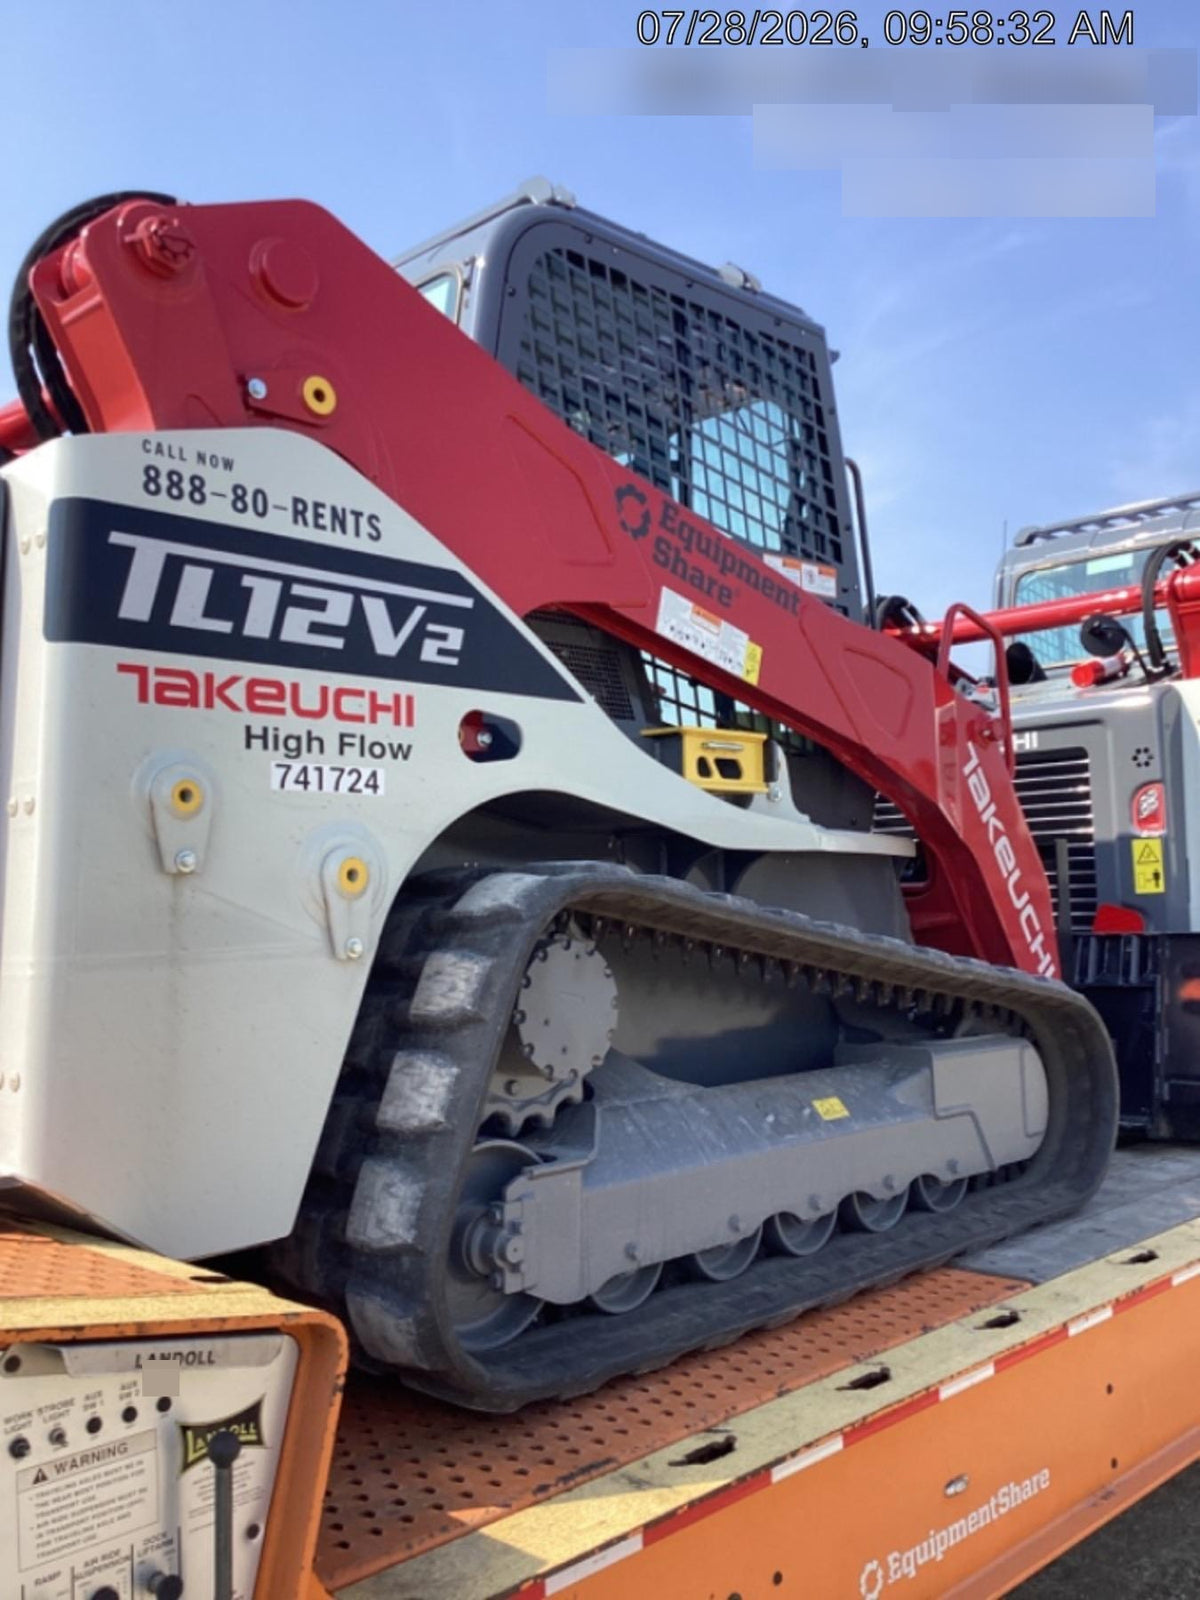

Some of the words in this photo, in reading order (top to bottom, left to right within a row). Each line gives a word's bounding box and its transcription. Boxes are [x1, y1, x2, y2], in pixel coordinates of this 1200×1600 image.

[142, 439, 187, 462] CALL
[197, 451, 235, 472] NOW
[142, 464, 383, 542] 888-80-RENTS
[653, 536, 733, 608] Share
[659, 500, 800, 616] Equipment
[117, 663, 415, 728] TAKEUCHI
[244, 725, 325, 759] High
[338, 732, 413, 761] Flow
[274, 763, 381, 796] 741724
[54, 1442, 129, 1475] WARNING
[887, 1467, 1050, 1584] EquipmentShare
